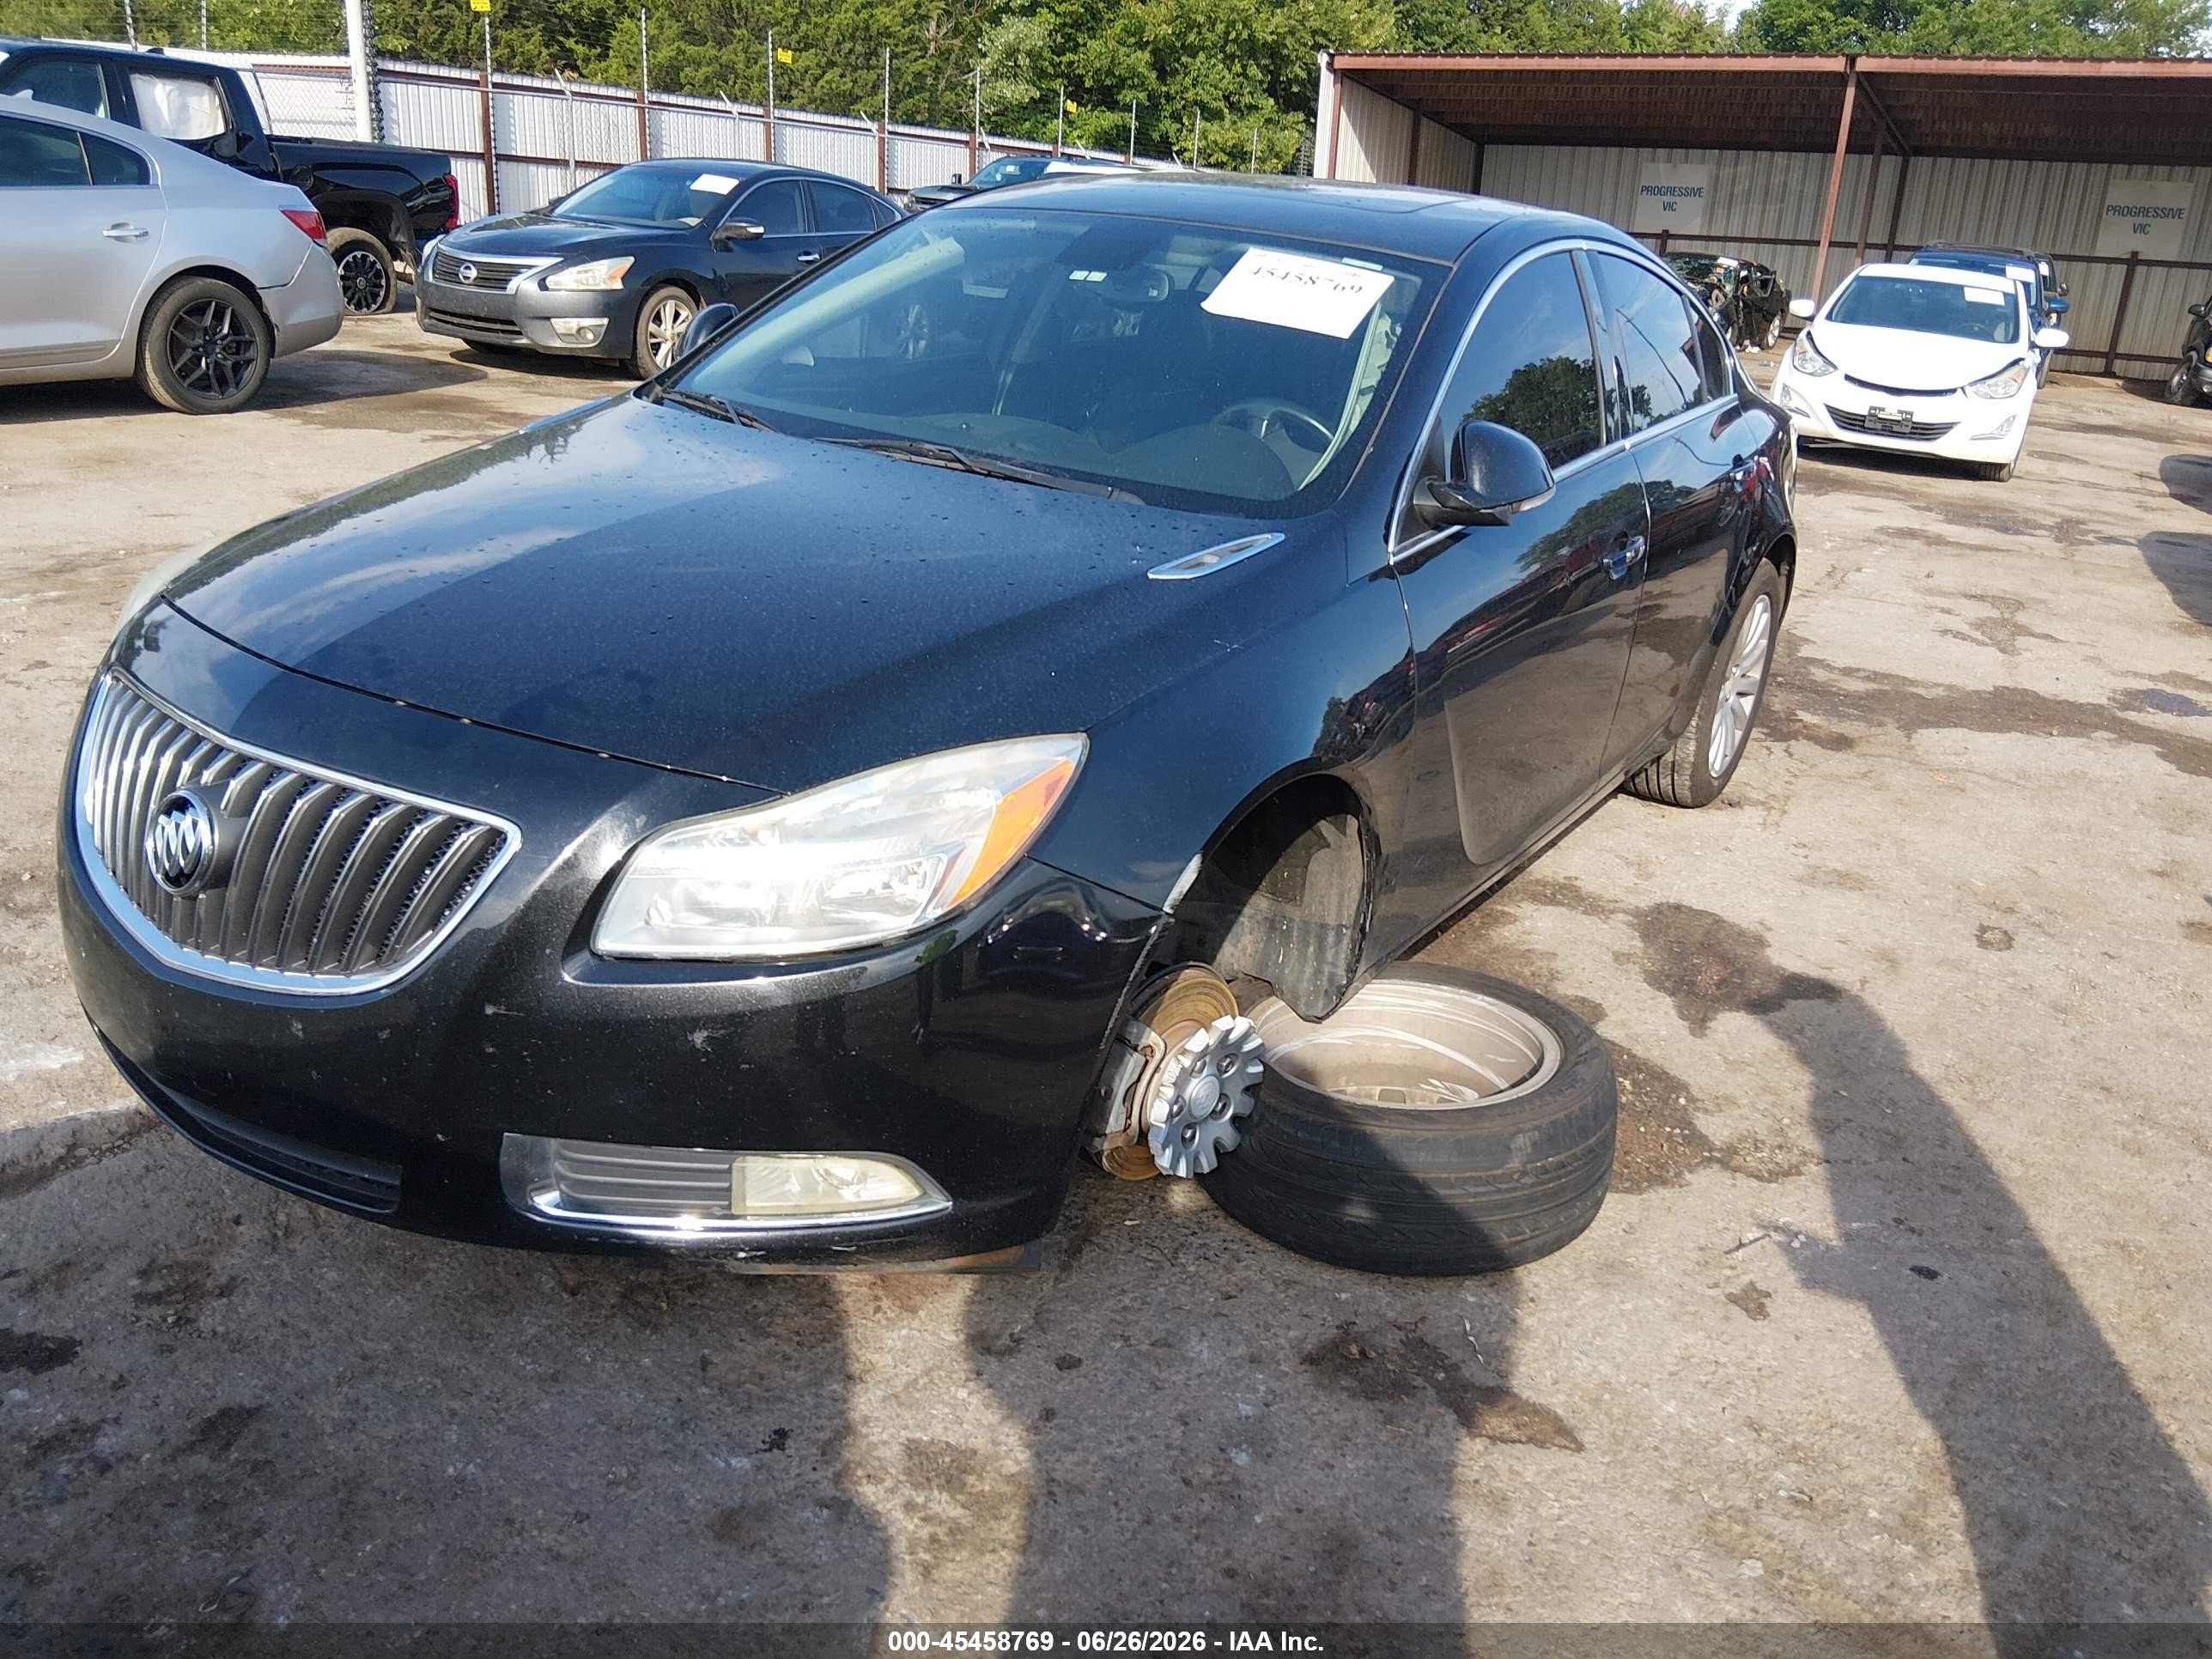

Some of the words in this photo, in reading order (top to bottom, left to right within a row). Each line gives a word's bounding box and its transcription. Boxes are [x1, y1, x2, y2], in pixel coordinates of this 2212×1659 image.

[1640, 185, 1705, 198] PROGRESSIVE
[1662, 201, 1677, 212] VIC
[2106, 204, 2185, 220] PROGRESSIVE
[2132, 222, 2151, 235] VIC
